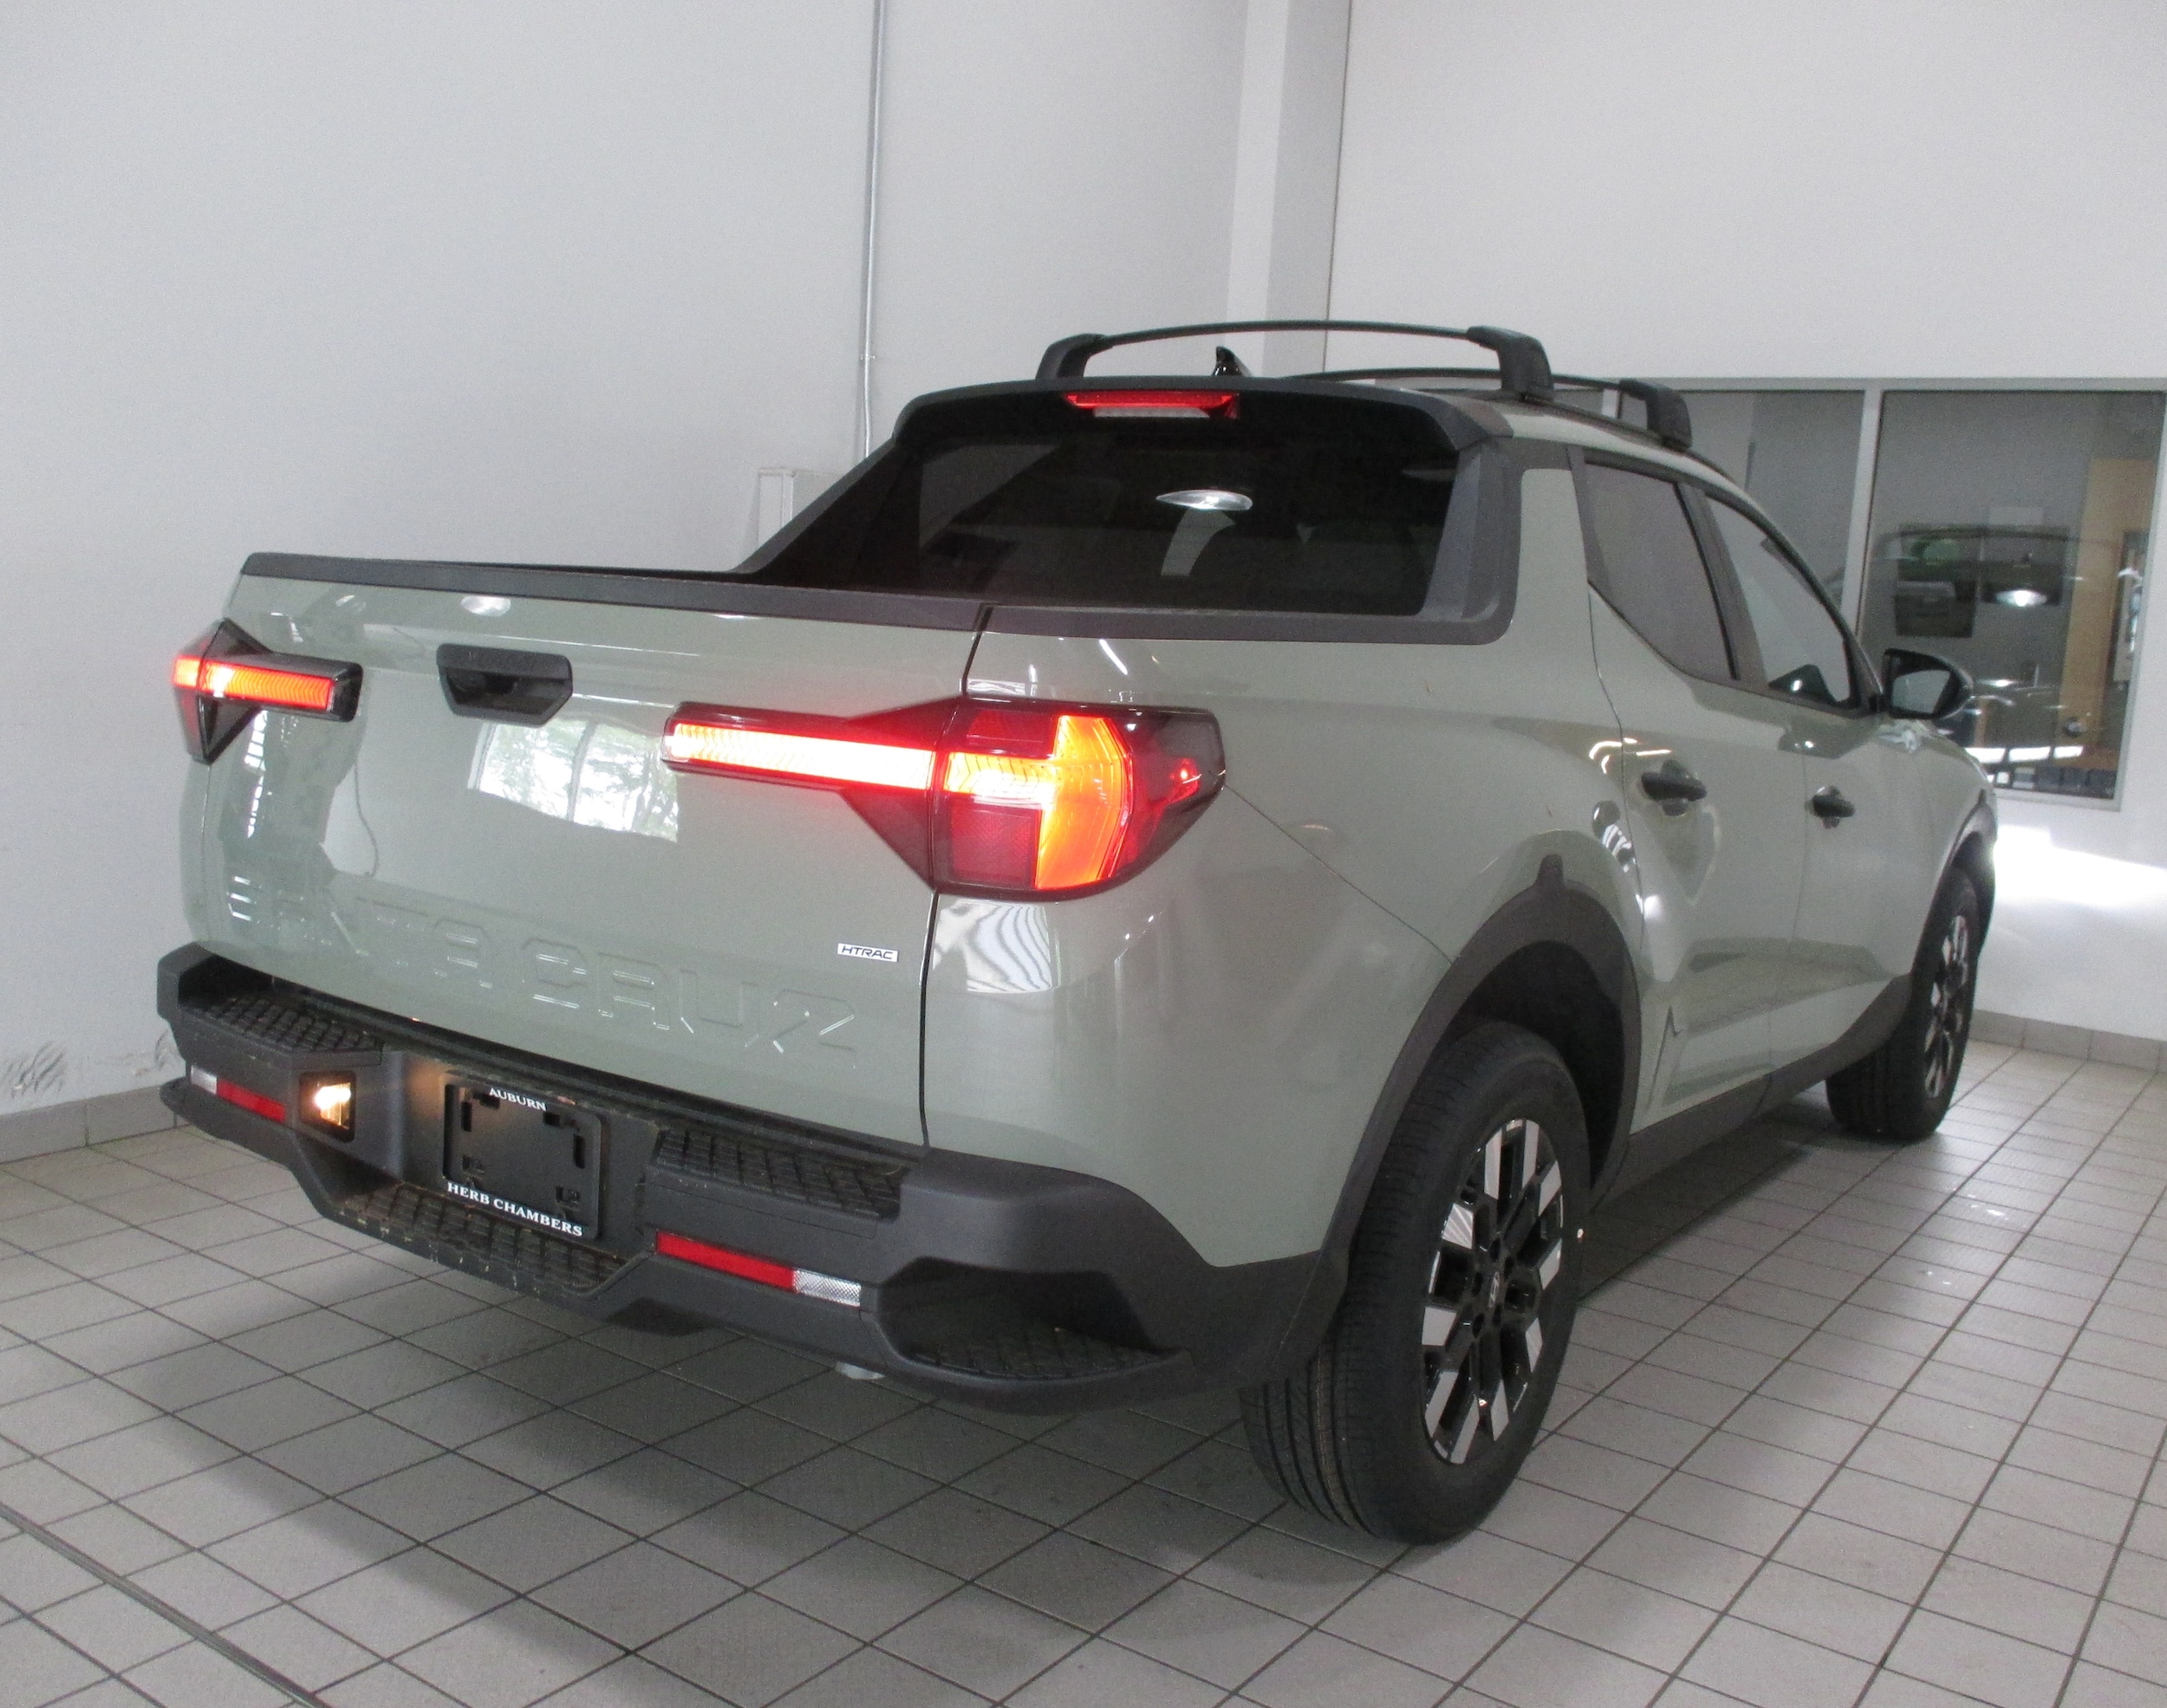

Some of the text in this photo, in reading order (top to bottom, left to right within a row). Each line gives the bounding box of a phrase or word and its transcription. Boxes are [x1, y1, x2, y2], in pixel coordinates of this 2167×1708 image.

[841, 945, 894, 960] HTRAC
[520, 936, 857, 1069] CRUZ
[489, 1088, 547, 1112] AUBURN
[447, 1181, 583, 1237] HERB CHAMBERS
